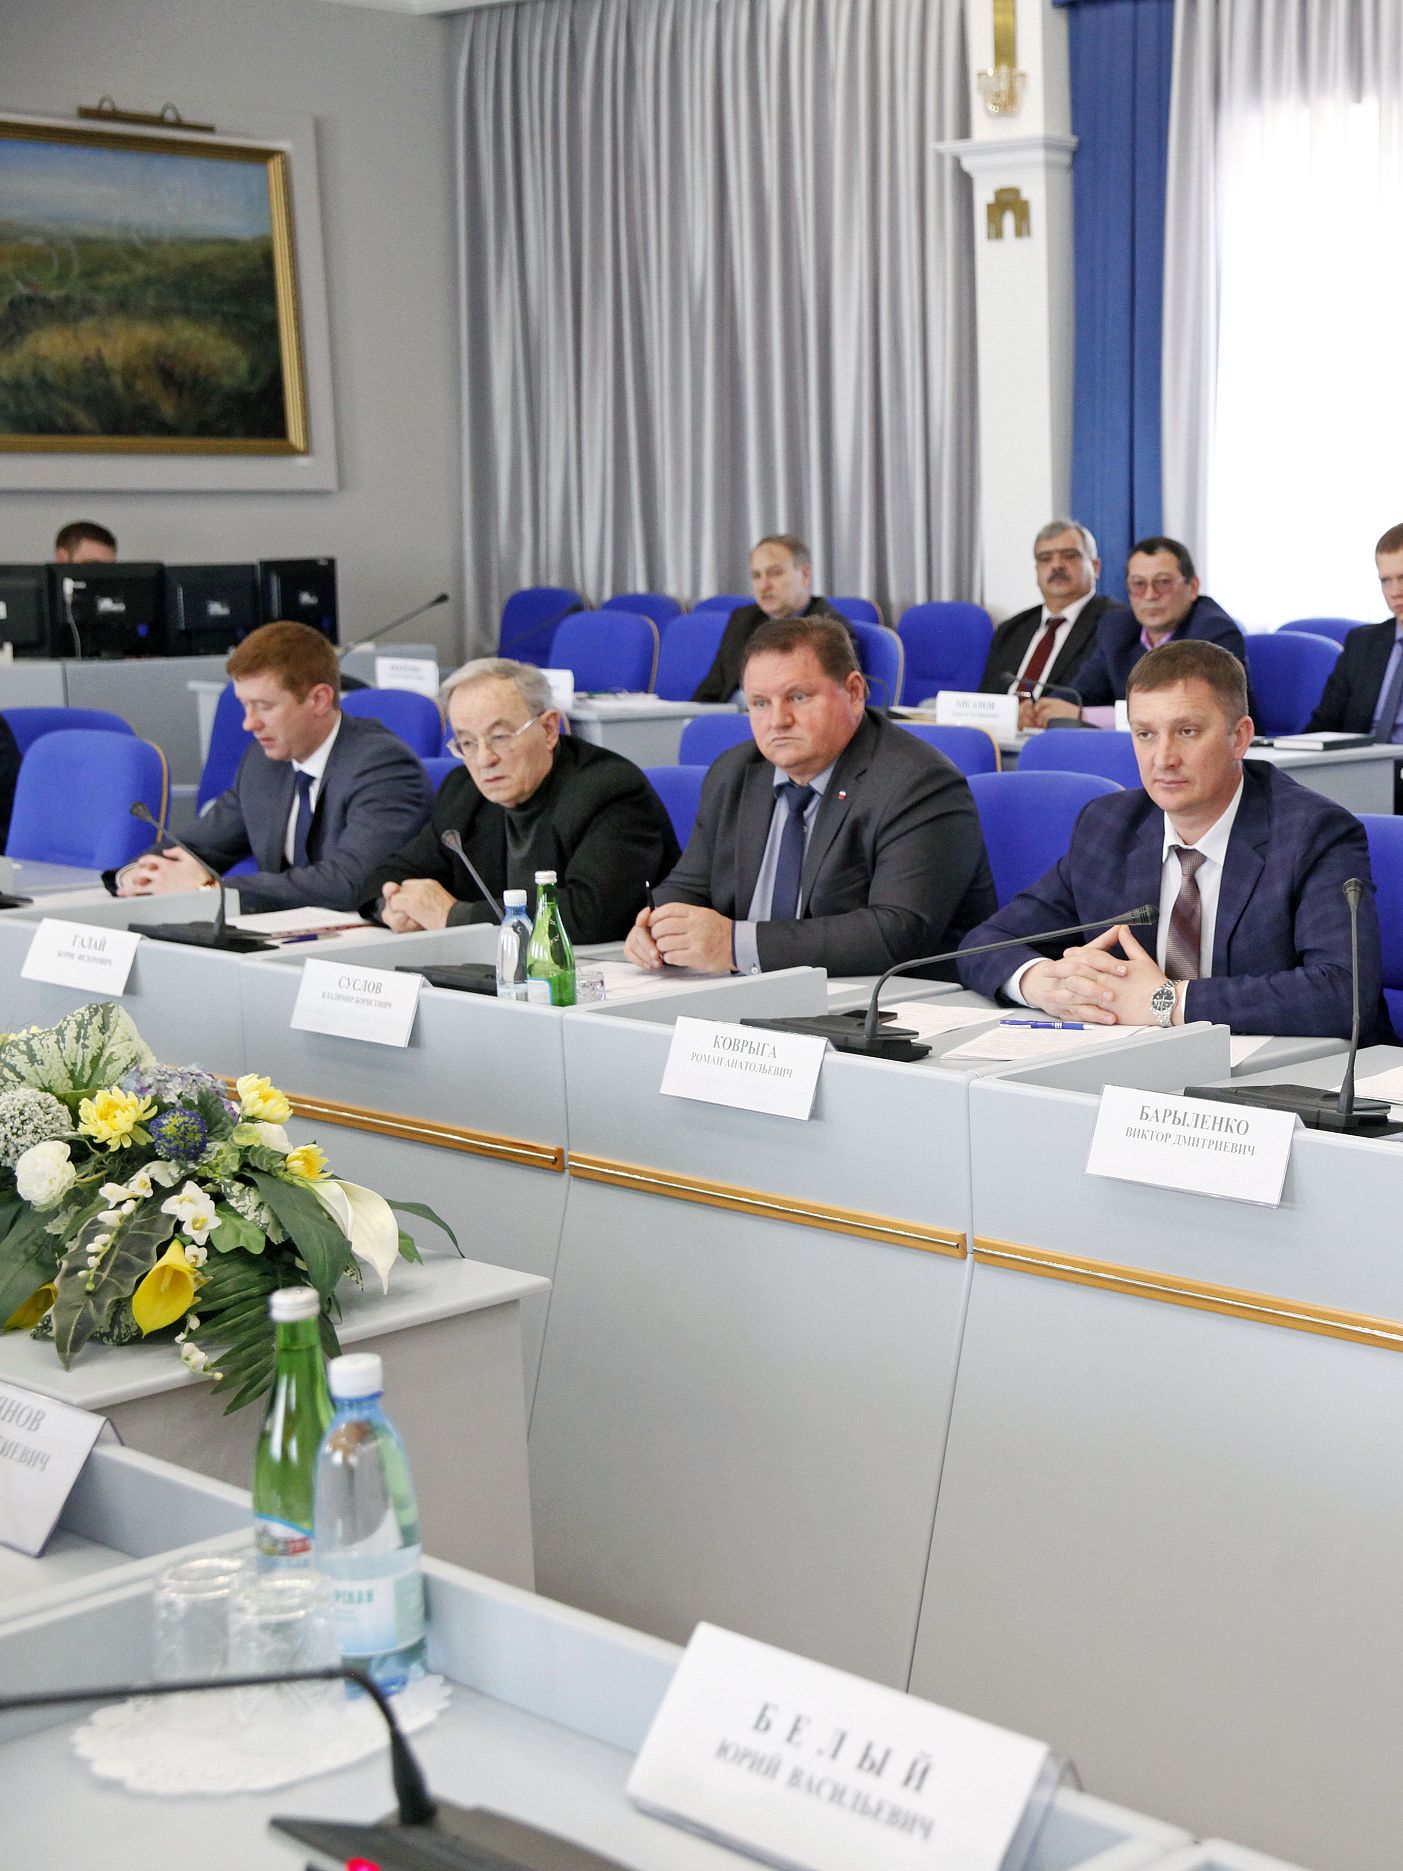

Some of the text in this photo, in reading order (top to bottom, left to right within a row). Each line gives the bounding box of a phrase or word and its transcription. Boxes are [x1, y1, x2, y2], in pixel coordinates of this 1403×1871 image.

[338, 976, 382, 994] СУСЛОВ
[712, 1035, 777, 1059] КОВРЫГА
[690, 1051, 793, 1079] РОМАН АНАТОЛЬЕВИЧ
[1139, 1105, 1250, 1136] БАРЫЛЕНКО
[1125, 1126, 1256, 1156] ВИКТОР ДМИТРИЕВИЧ
[752, 1702, 934, 1793] БЕЛЫЙ
[714, 1738, 936, 1840] ЮРИЙ ВАСИЛЬЕВИЧ
